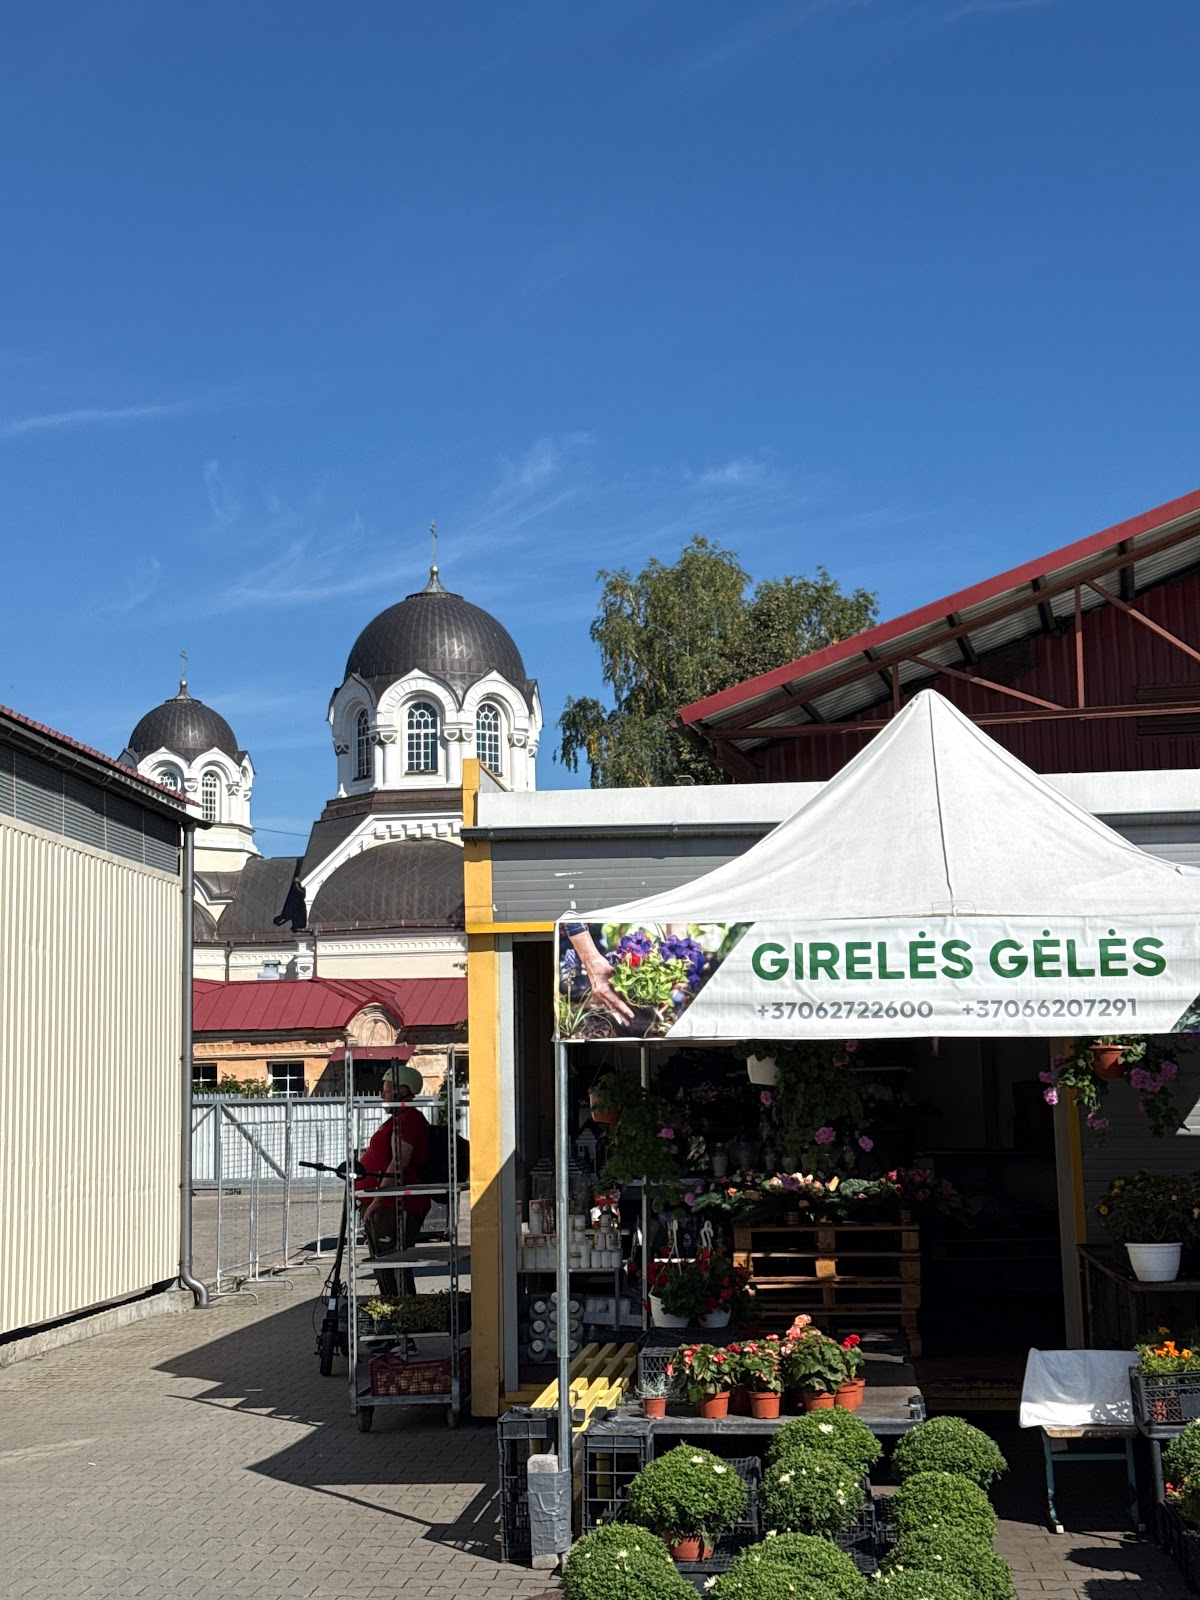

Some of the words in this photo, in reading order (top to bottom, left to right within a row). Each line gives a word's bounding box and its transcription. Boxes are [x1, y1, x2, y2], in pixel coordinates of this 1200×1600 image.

[751, 931, 973, 980] GIRELĖS
[989, 929, 1166, 979] GĖLĖS
[757, 1002, 934, 1020] +37062722600
[962, 998, 1137, 1018] +37066207291
